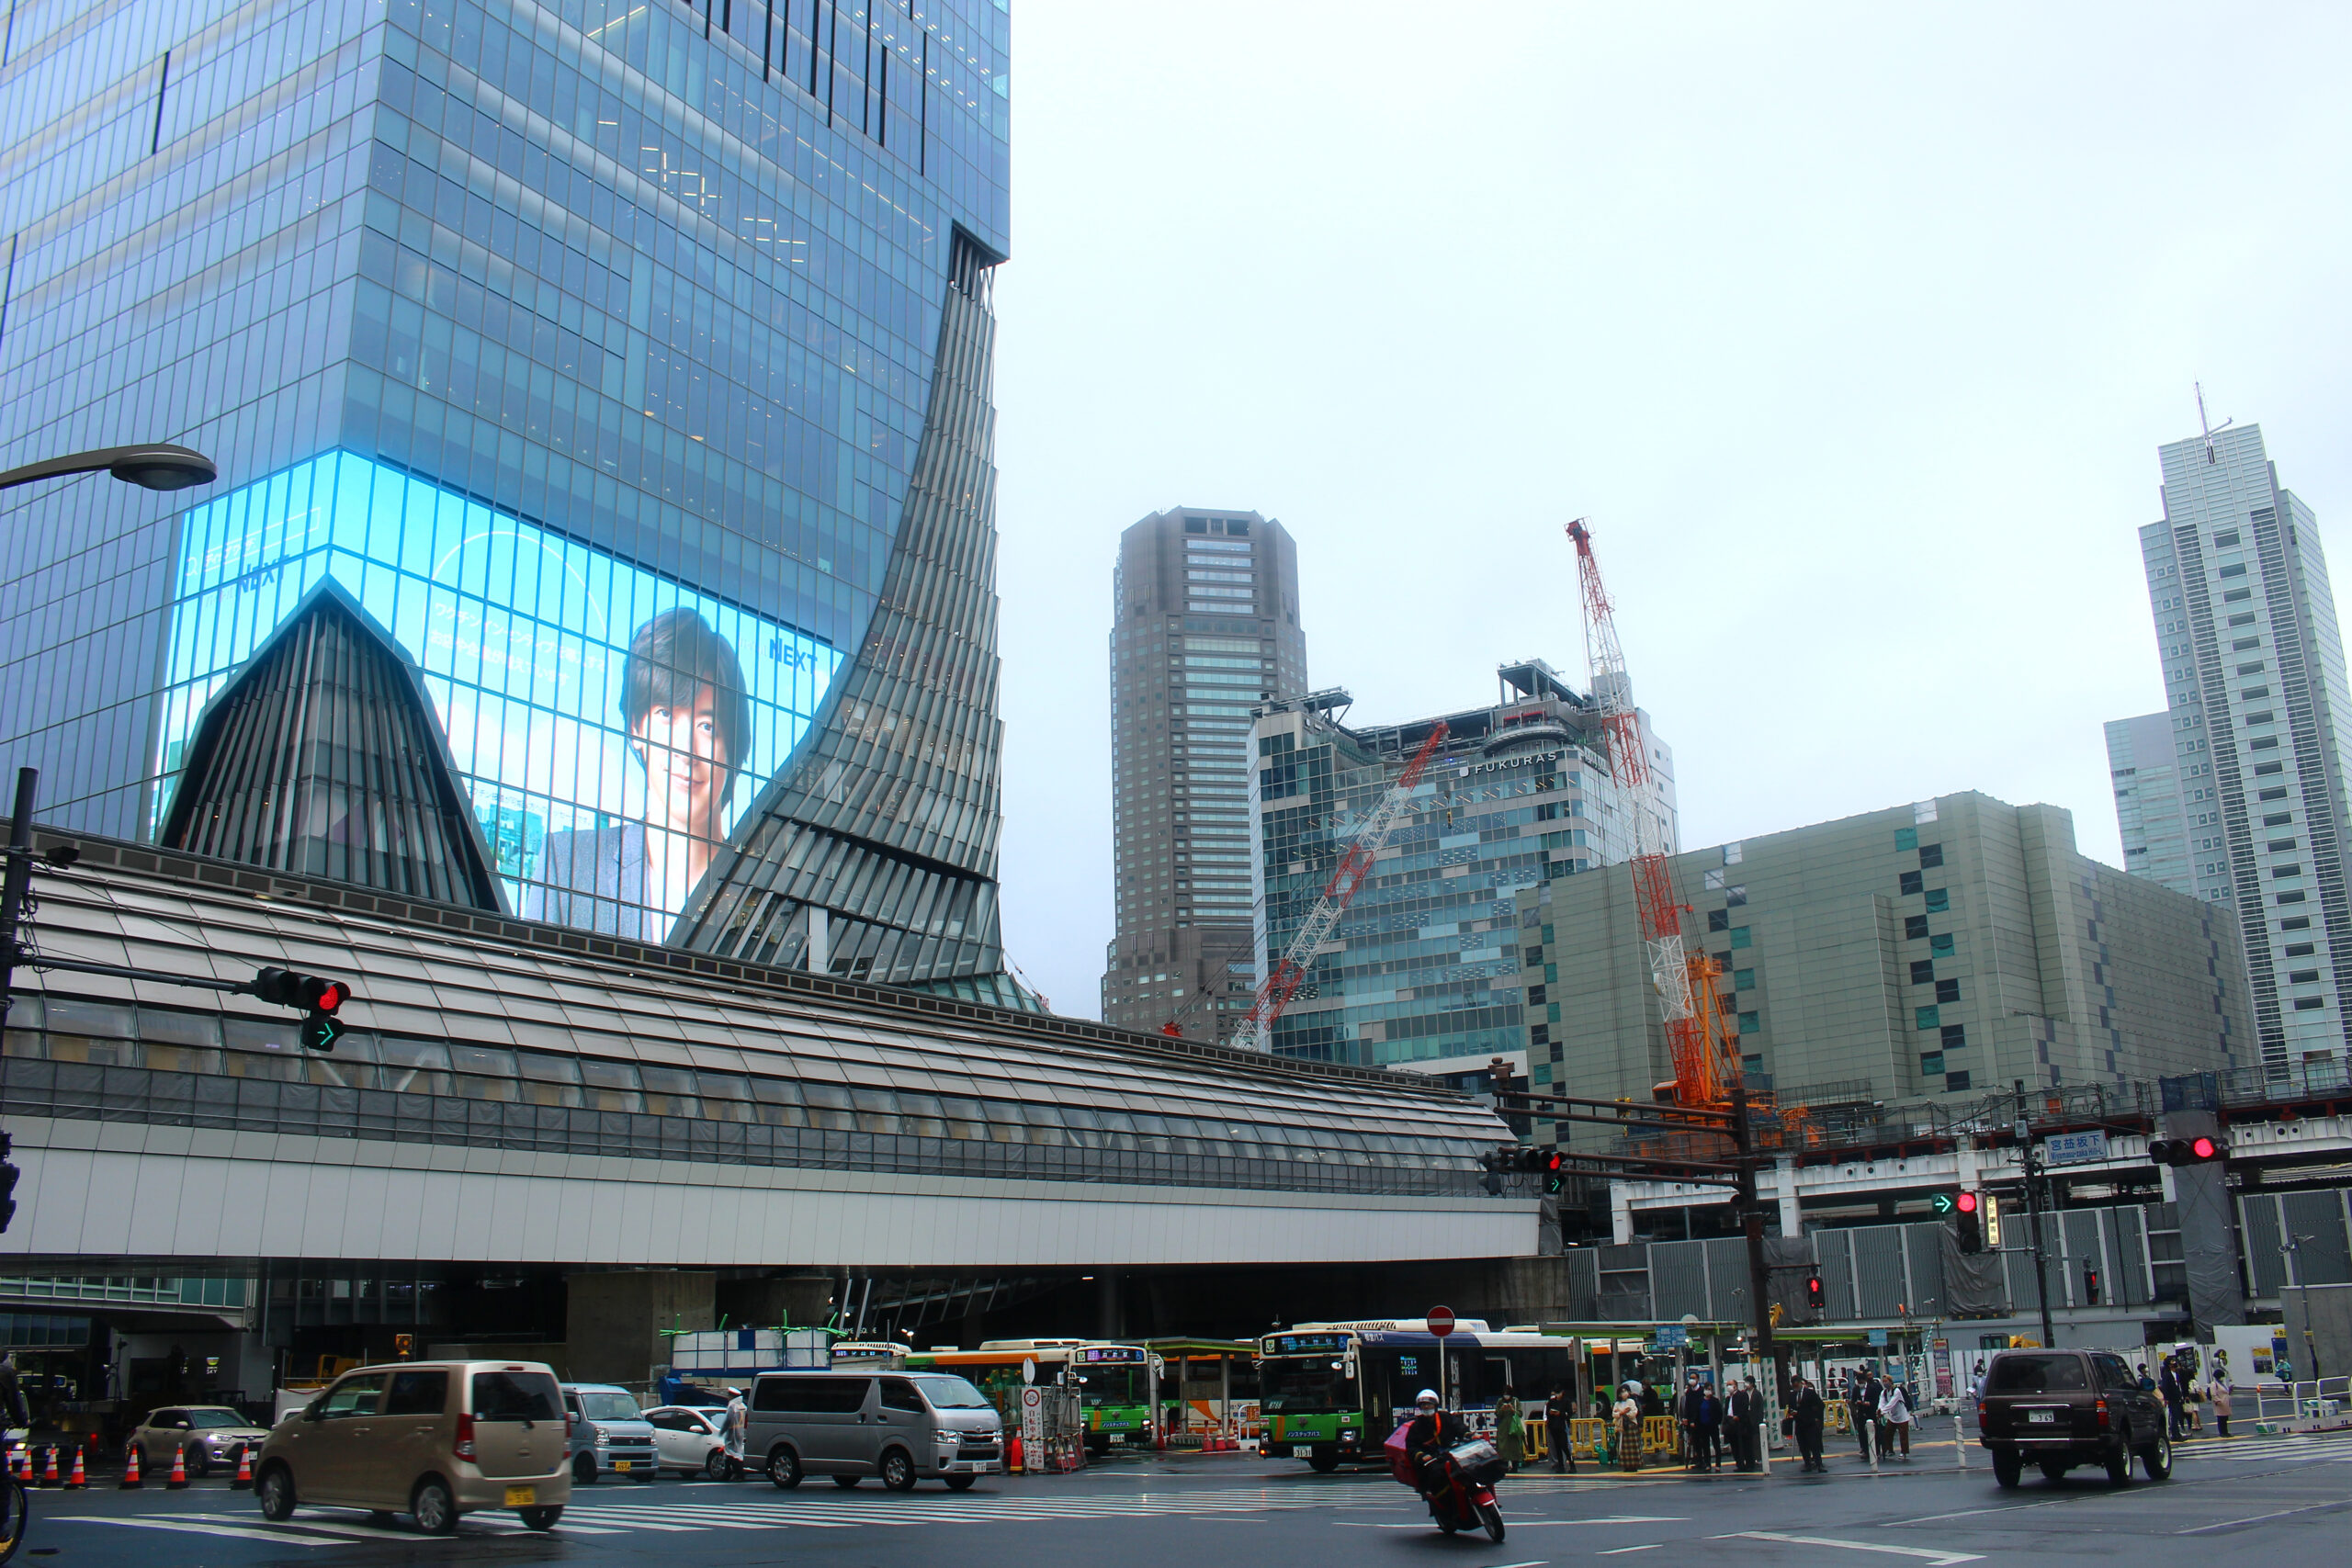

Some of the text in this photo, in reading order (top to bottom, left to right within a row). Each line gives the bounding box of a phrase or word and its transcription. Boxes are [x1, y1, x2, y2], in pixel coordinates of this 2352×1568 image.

[769, 637, 818, 675] NEXT
[1475, 751, 1557, 774] FUKURAS
[2051, 1134, 2100, 1151] 宮益坂下
[1987, 1197, 1997, 1243] 右折車専用
